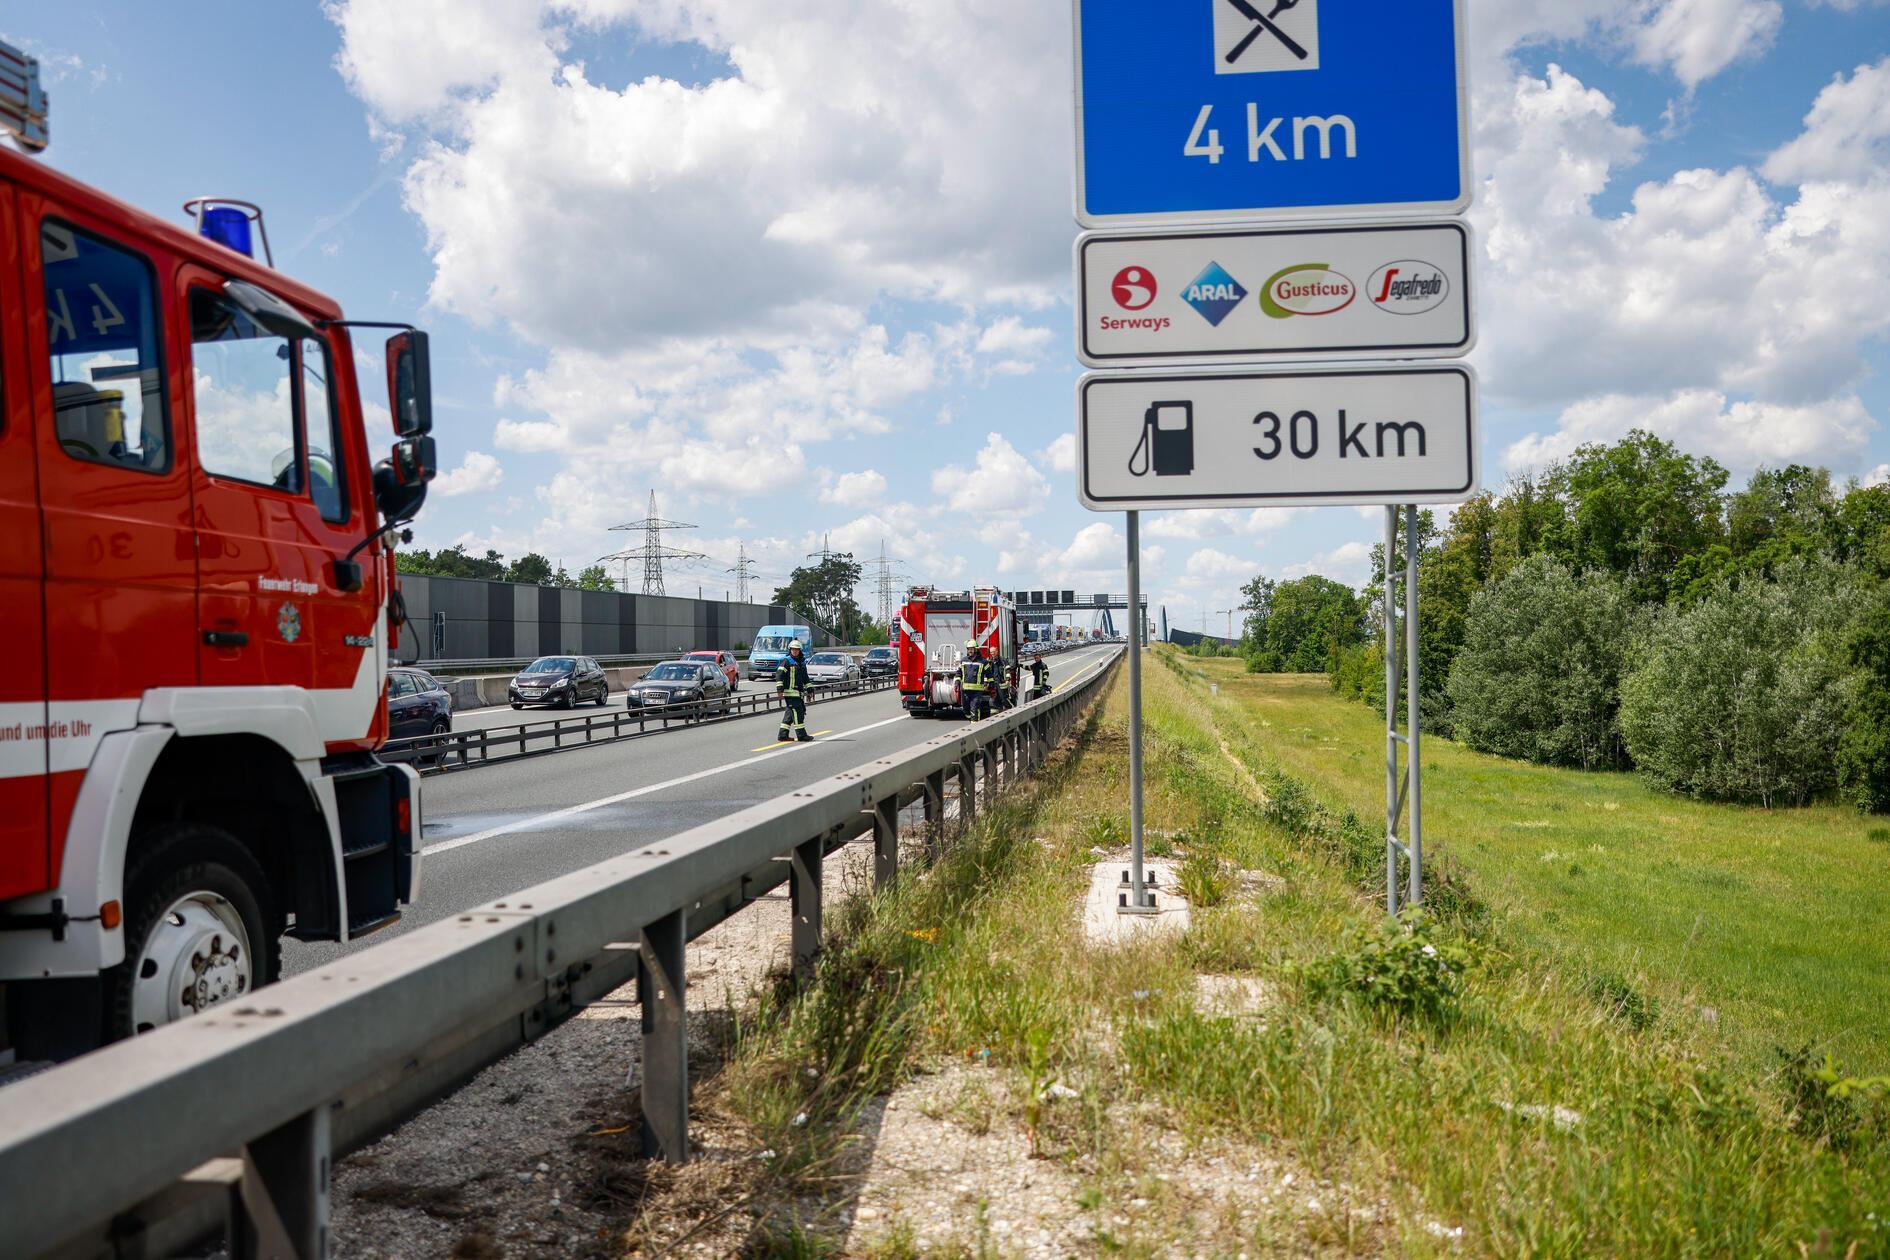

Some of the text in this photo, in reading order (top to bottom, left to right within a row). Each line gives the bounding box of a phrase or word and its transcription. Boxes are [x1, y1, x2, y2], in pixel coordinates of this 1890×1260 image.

[1184, 102, 1357, 164] 4 km
[1187, 283, 1240, 301] ARAL
[1276, 280, 1349, 299] Gusticus
[1375, 268, 1442, 302] Segafredo
[1100, 315, 1170, 332] Serways
[1252, 409, 1427, 460] 30 km
[26, 725, 48, 740] um
[50, 720, 68, 738] die
[71, 718, 92, 737] Uhr
